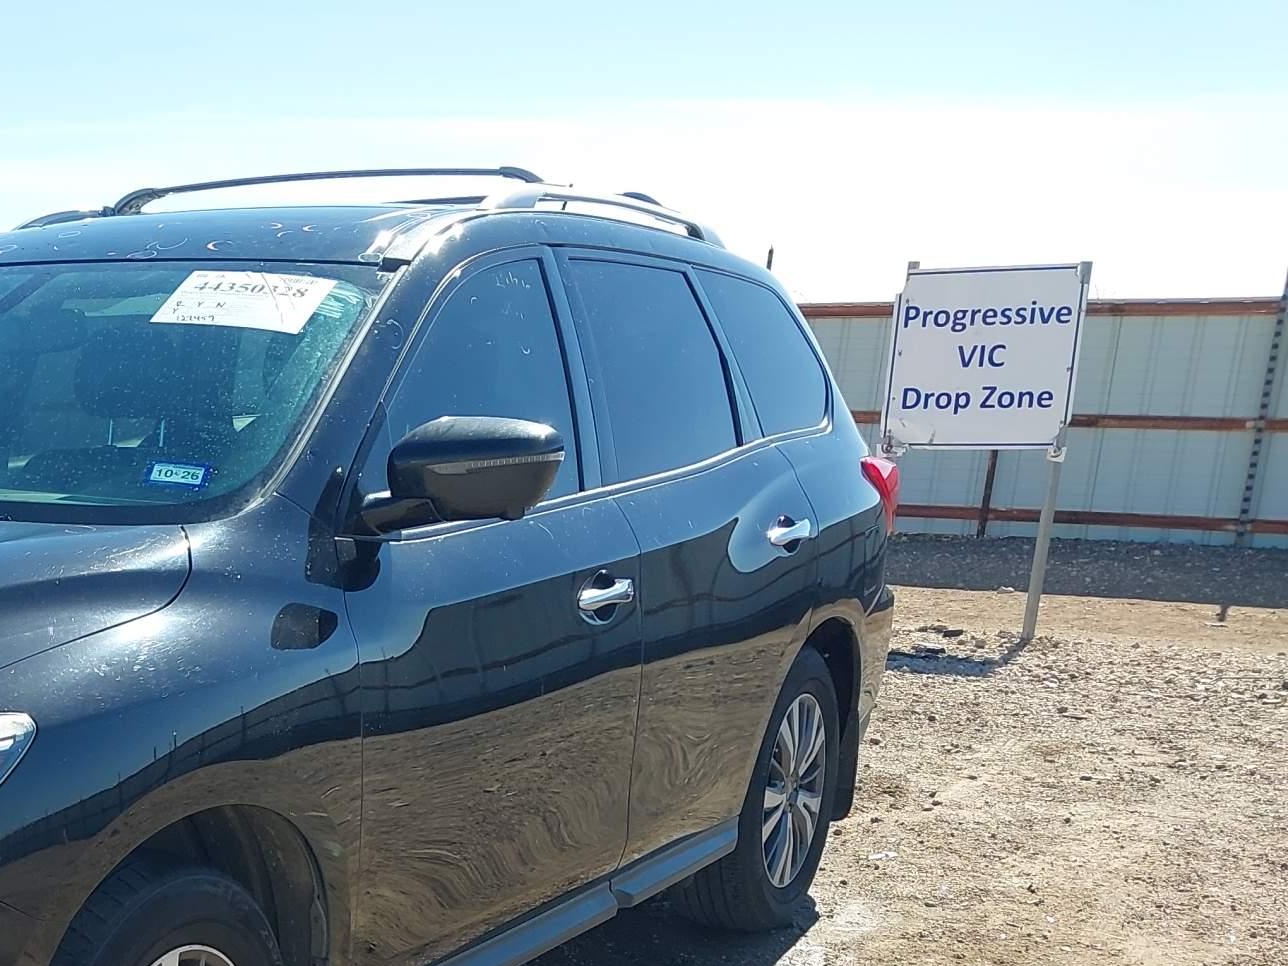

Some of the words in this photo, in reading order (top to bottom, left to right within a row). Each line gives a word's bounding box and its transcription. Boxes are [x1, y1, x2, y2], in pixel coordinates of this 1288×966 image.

[194, 280, 309, 298] 44350328
[903, 300, 1073, 333] Progressive
[958, 344, 1007, 368] VIC
[901, 387, 971, 415] Drop
[979, 386, 1054, 409] Zone
